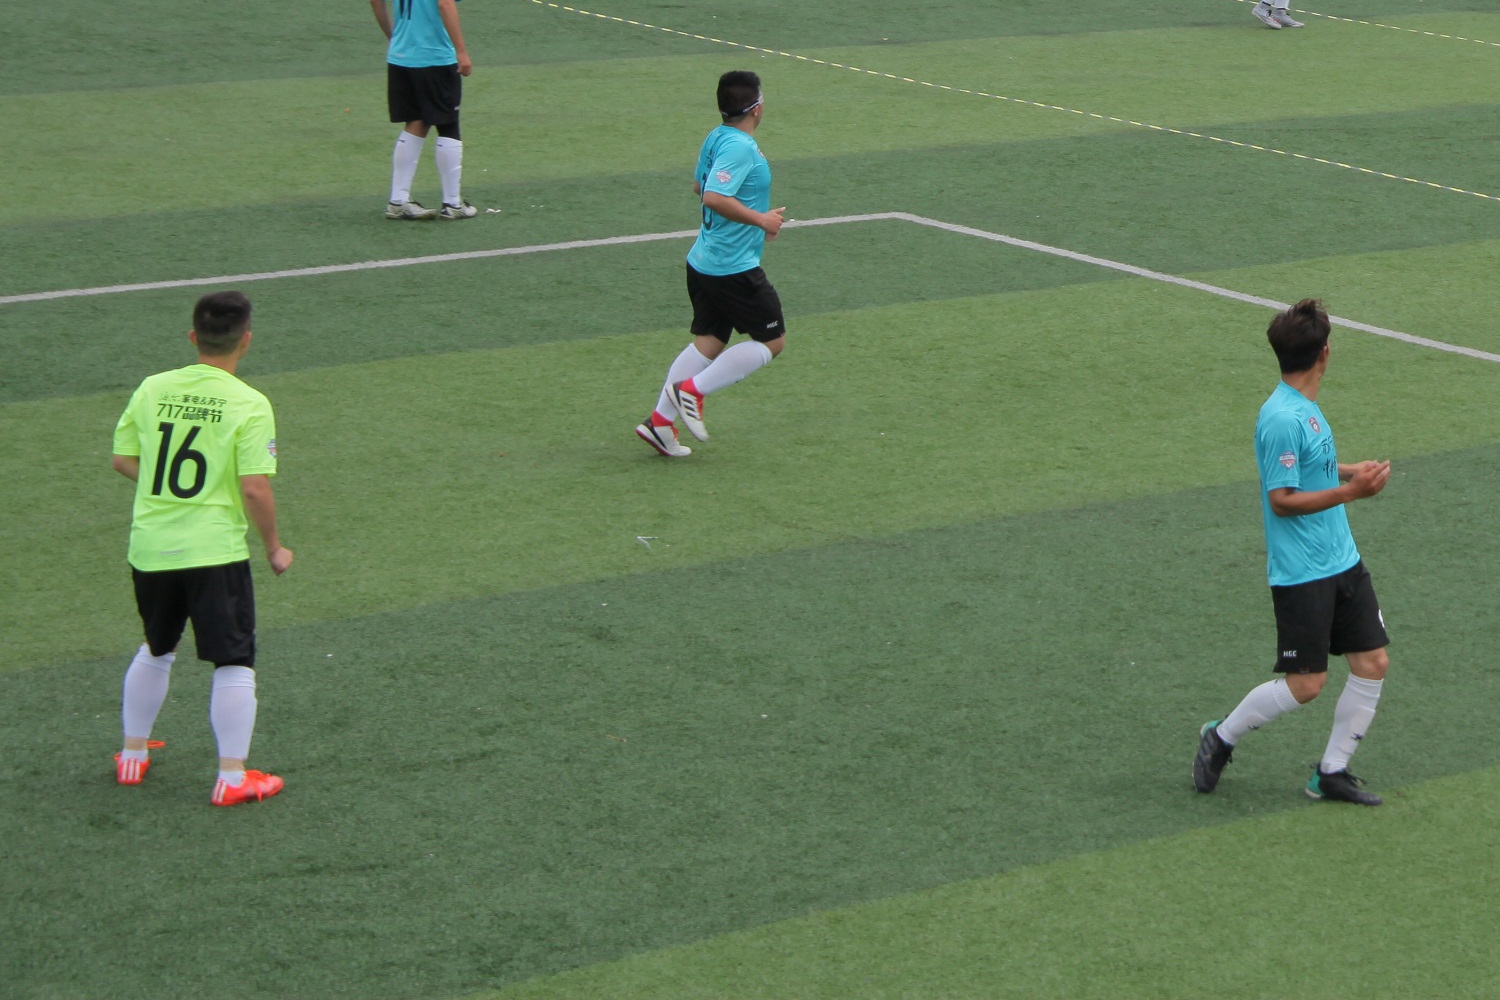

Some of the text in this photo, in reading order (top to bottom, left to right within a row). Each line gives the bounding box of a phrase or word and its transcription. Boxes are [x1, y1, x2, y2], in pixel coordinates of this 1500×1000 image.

[157, 403, 223, 423] 717品牌节
[152, 421, 207, 499] 16
